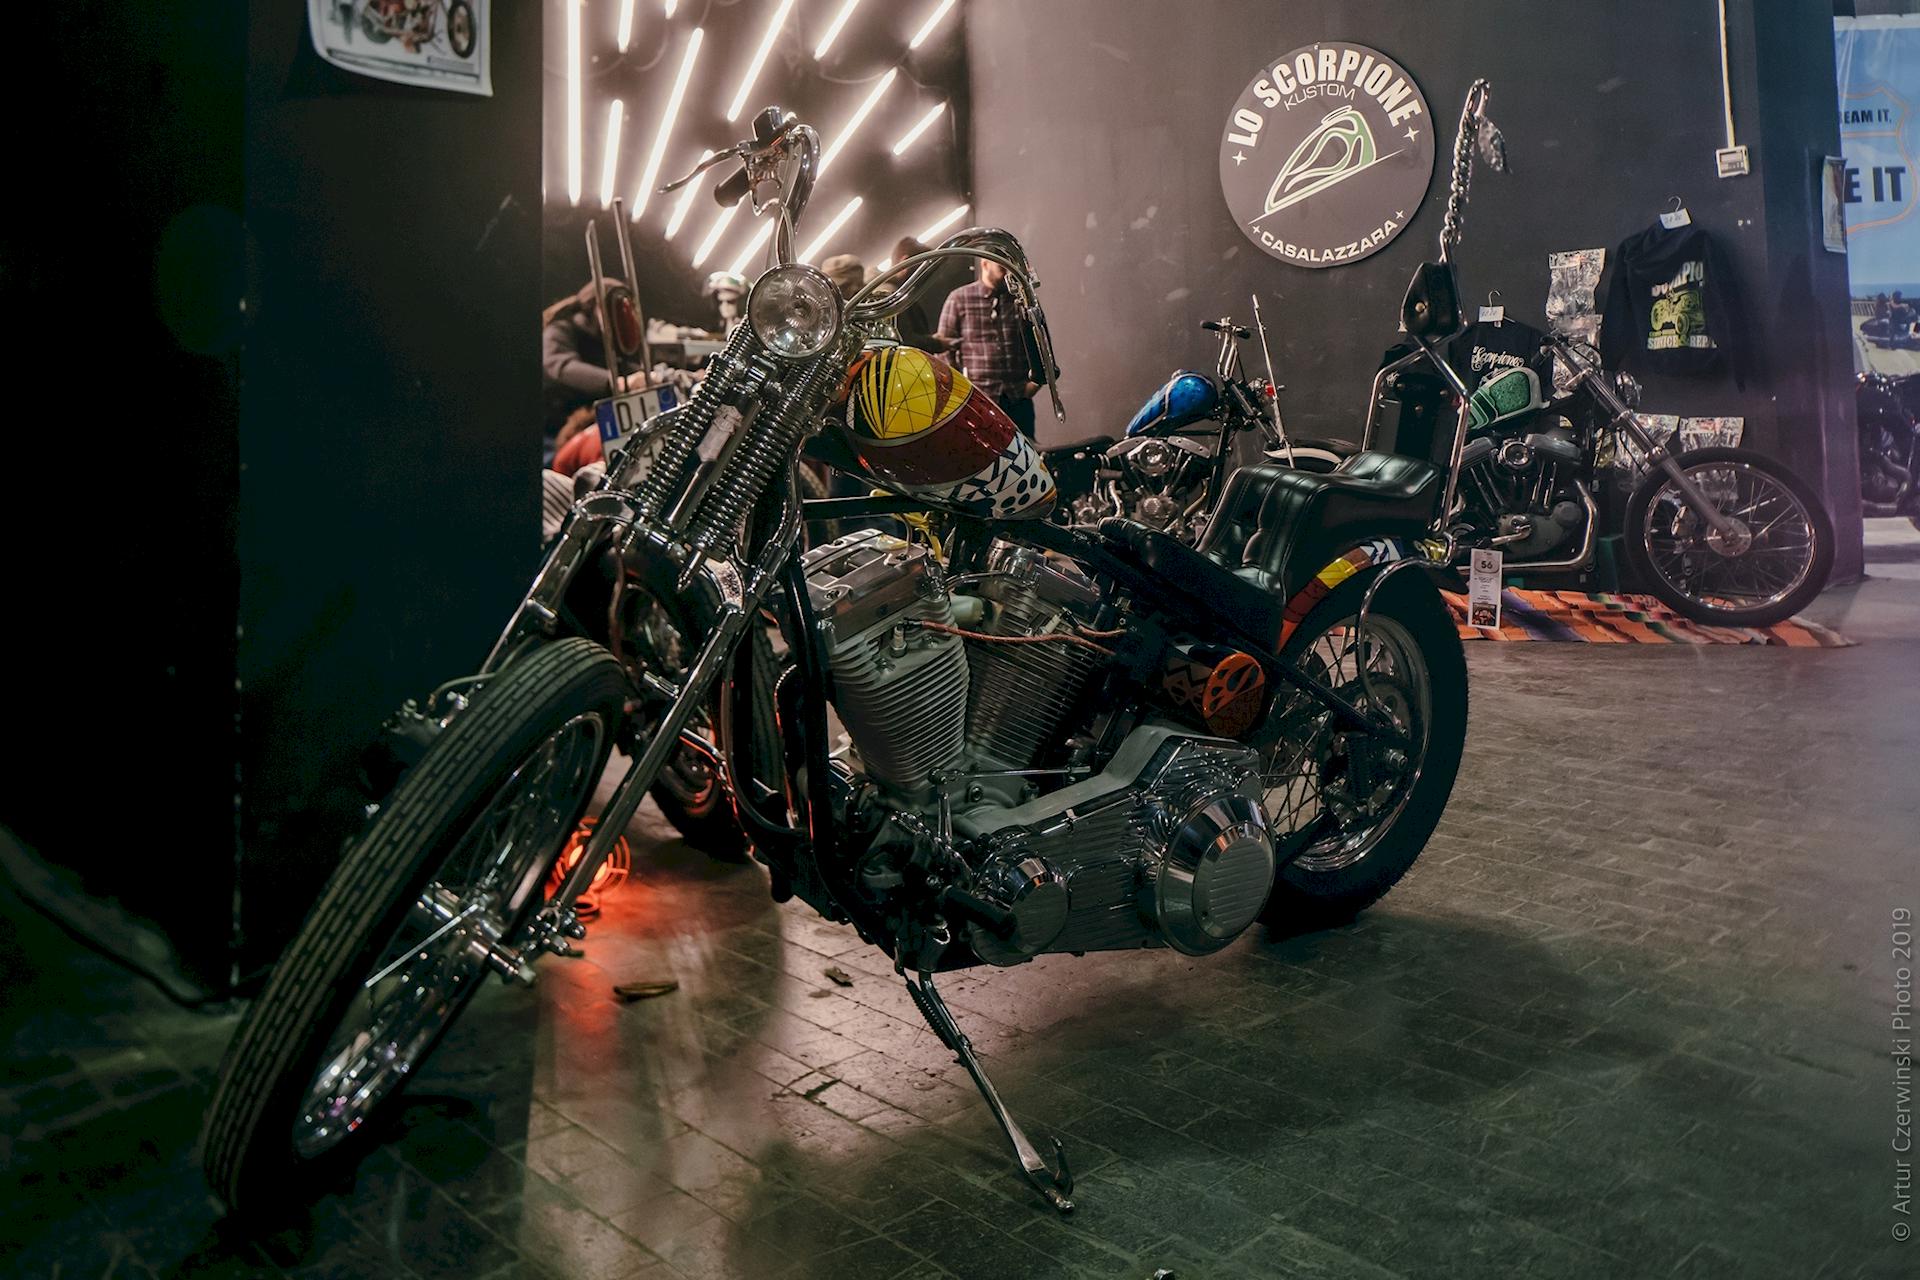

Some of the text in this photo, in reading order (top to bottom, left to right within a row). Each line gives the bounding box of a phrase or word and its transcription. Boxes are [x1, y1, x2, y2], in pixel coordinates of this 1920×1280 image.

[1228, 49, 1422, 147] LO SCORPIONE
[1284, 83, 1356, 111] KUSTOM
[1840, 109, 1873, 124] EAM
[1872, 166, 1906, 202] IT
[1260, 220, 1398, 262] CASALAZZARA
[1481, 560, 1493, 569] 56
